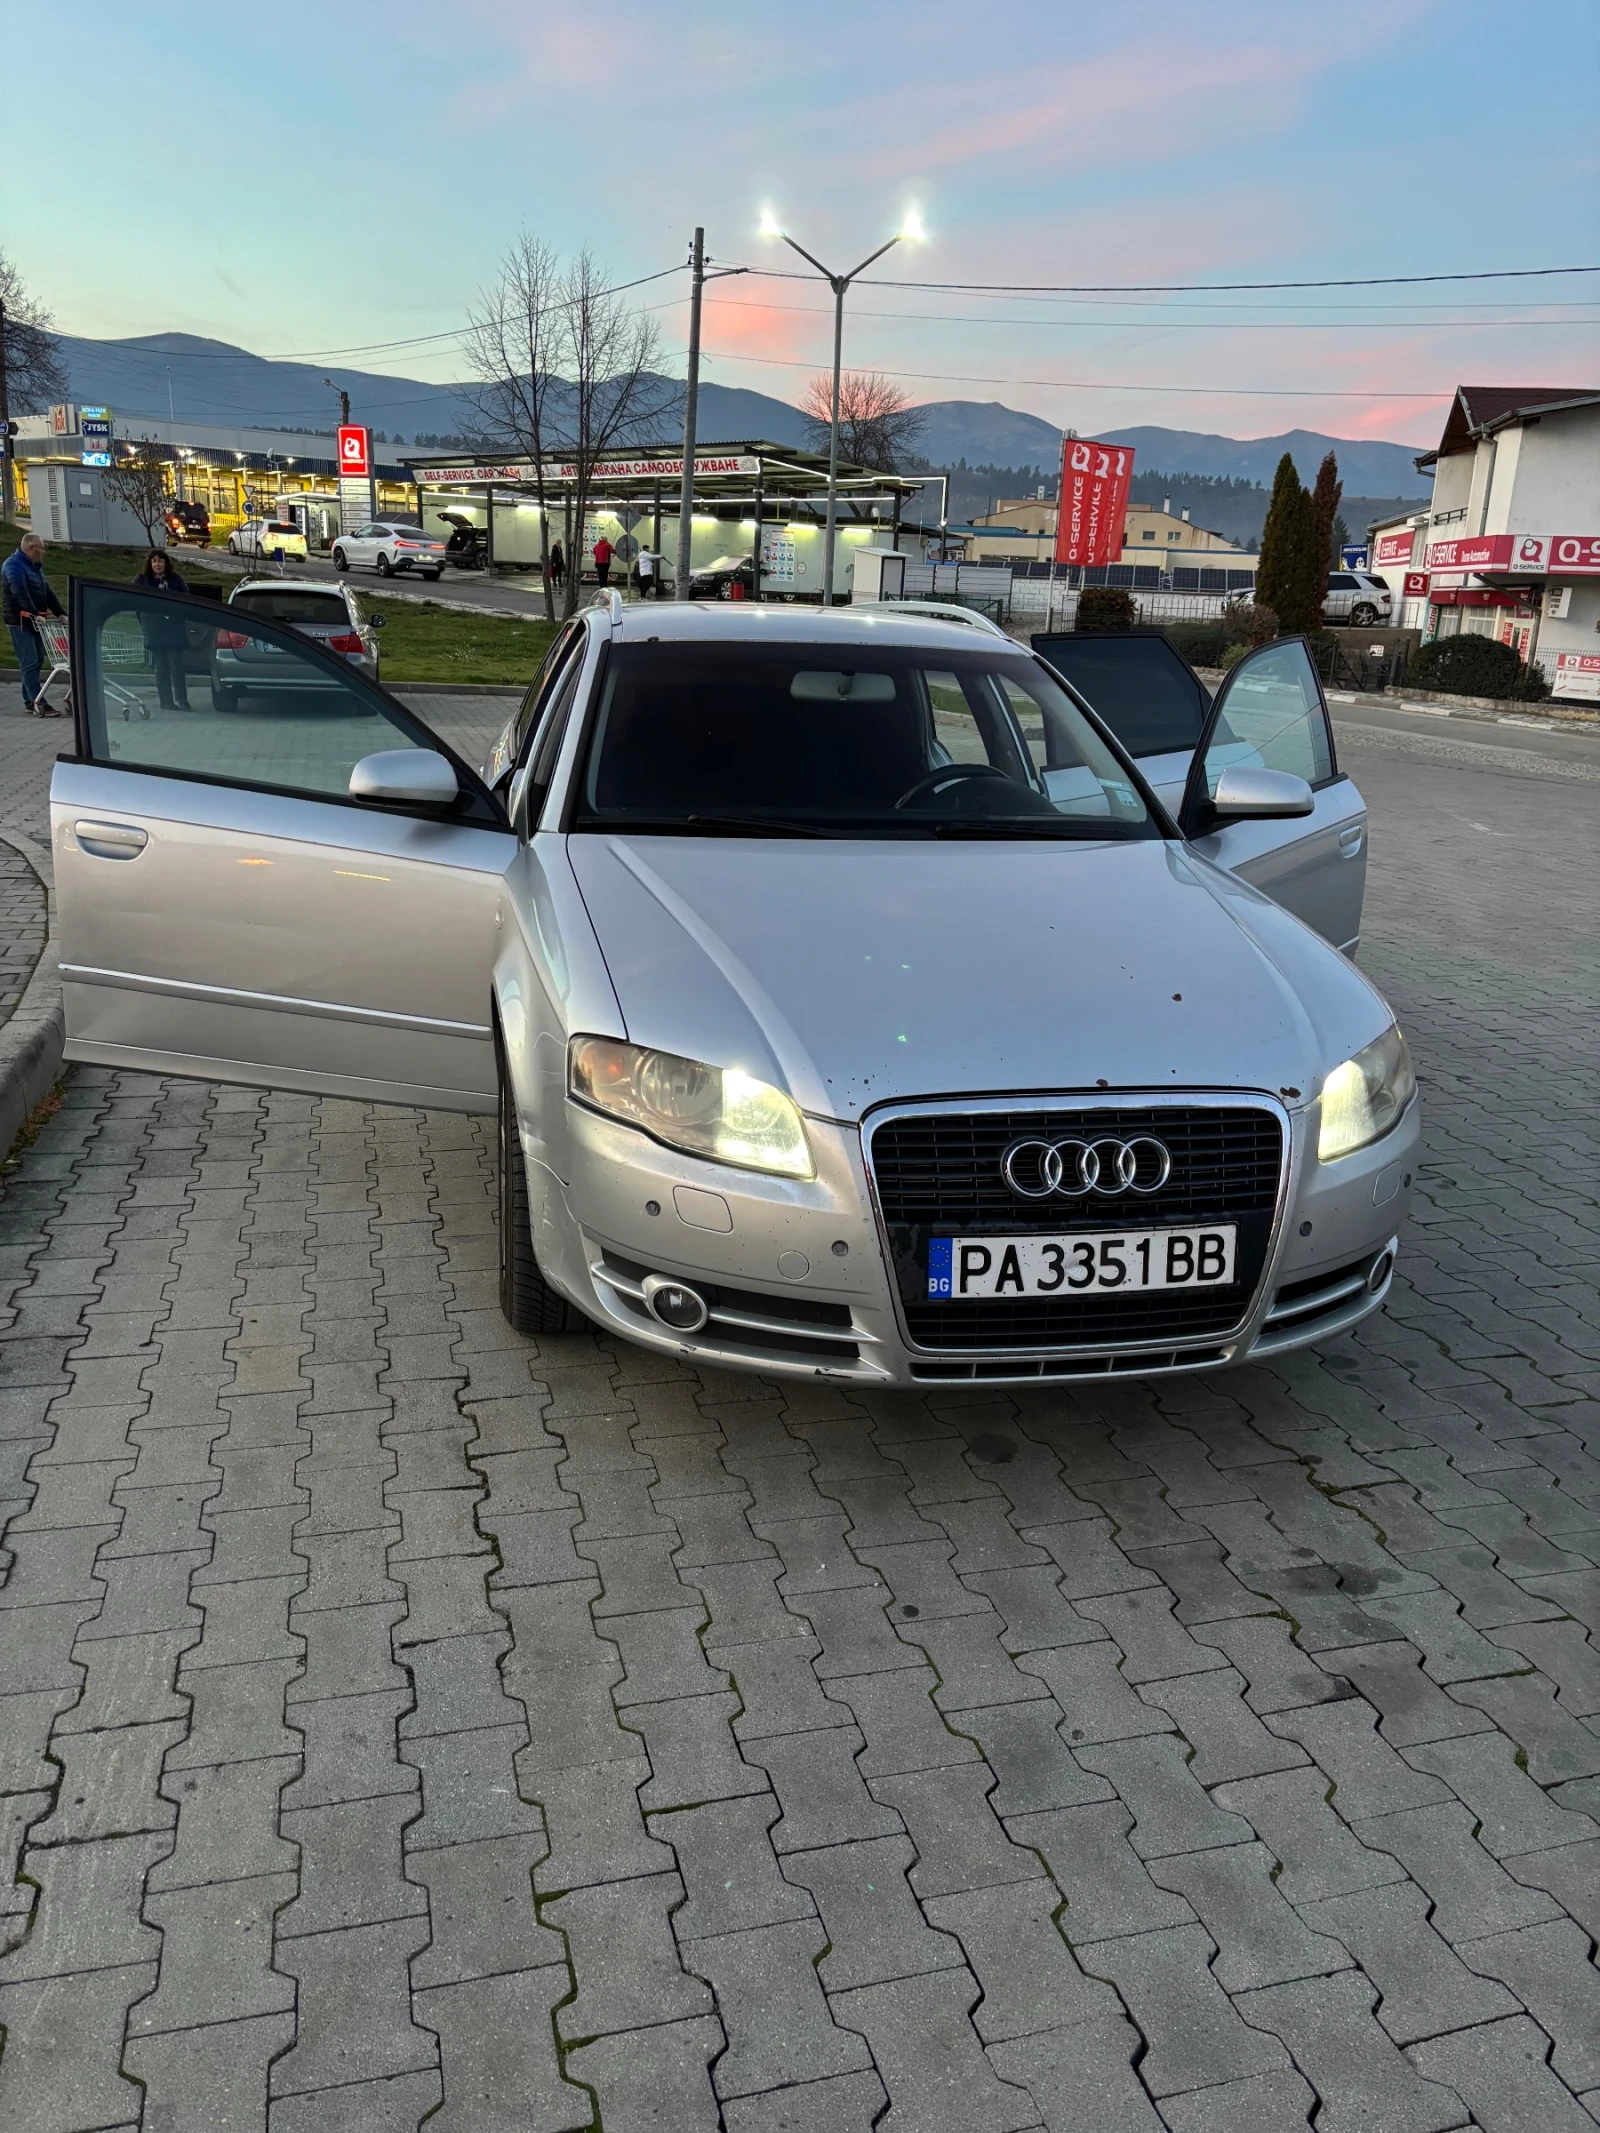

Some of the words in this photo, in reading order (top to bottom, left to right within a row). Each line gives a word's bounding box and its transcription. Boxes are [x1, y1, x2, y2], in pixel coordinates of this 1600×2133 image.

[87, 423, 108, 432] JYSK
[424, 469, 475, 481] SELF-SERVICE
[477, 468, 494, 479] CAR
[497, 467, 521, 478] WASH
[1428, 606, 1438, 633] Castrol
[959, 1244, 1025, 1294] PA
[1037, 1237, 1150, 1292] 3351
[1166, 1233, 1227, 1284] BB
[929, 1277, 949, 1292] BG
